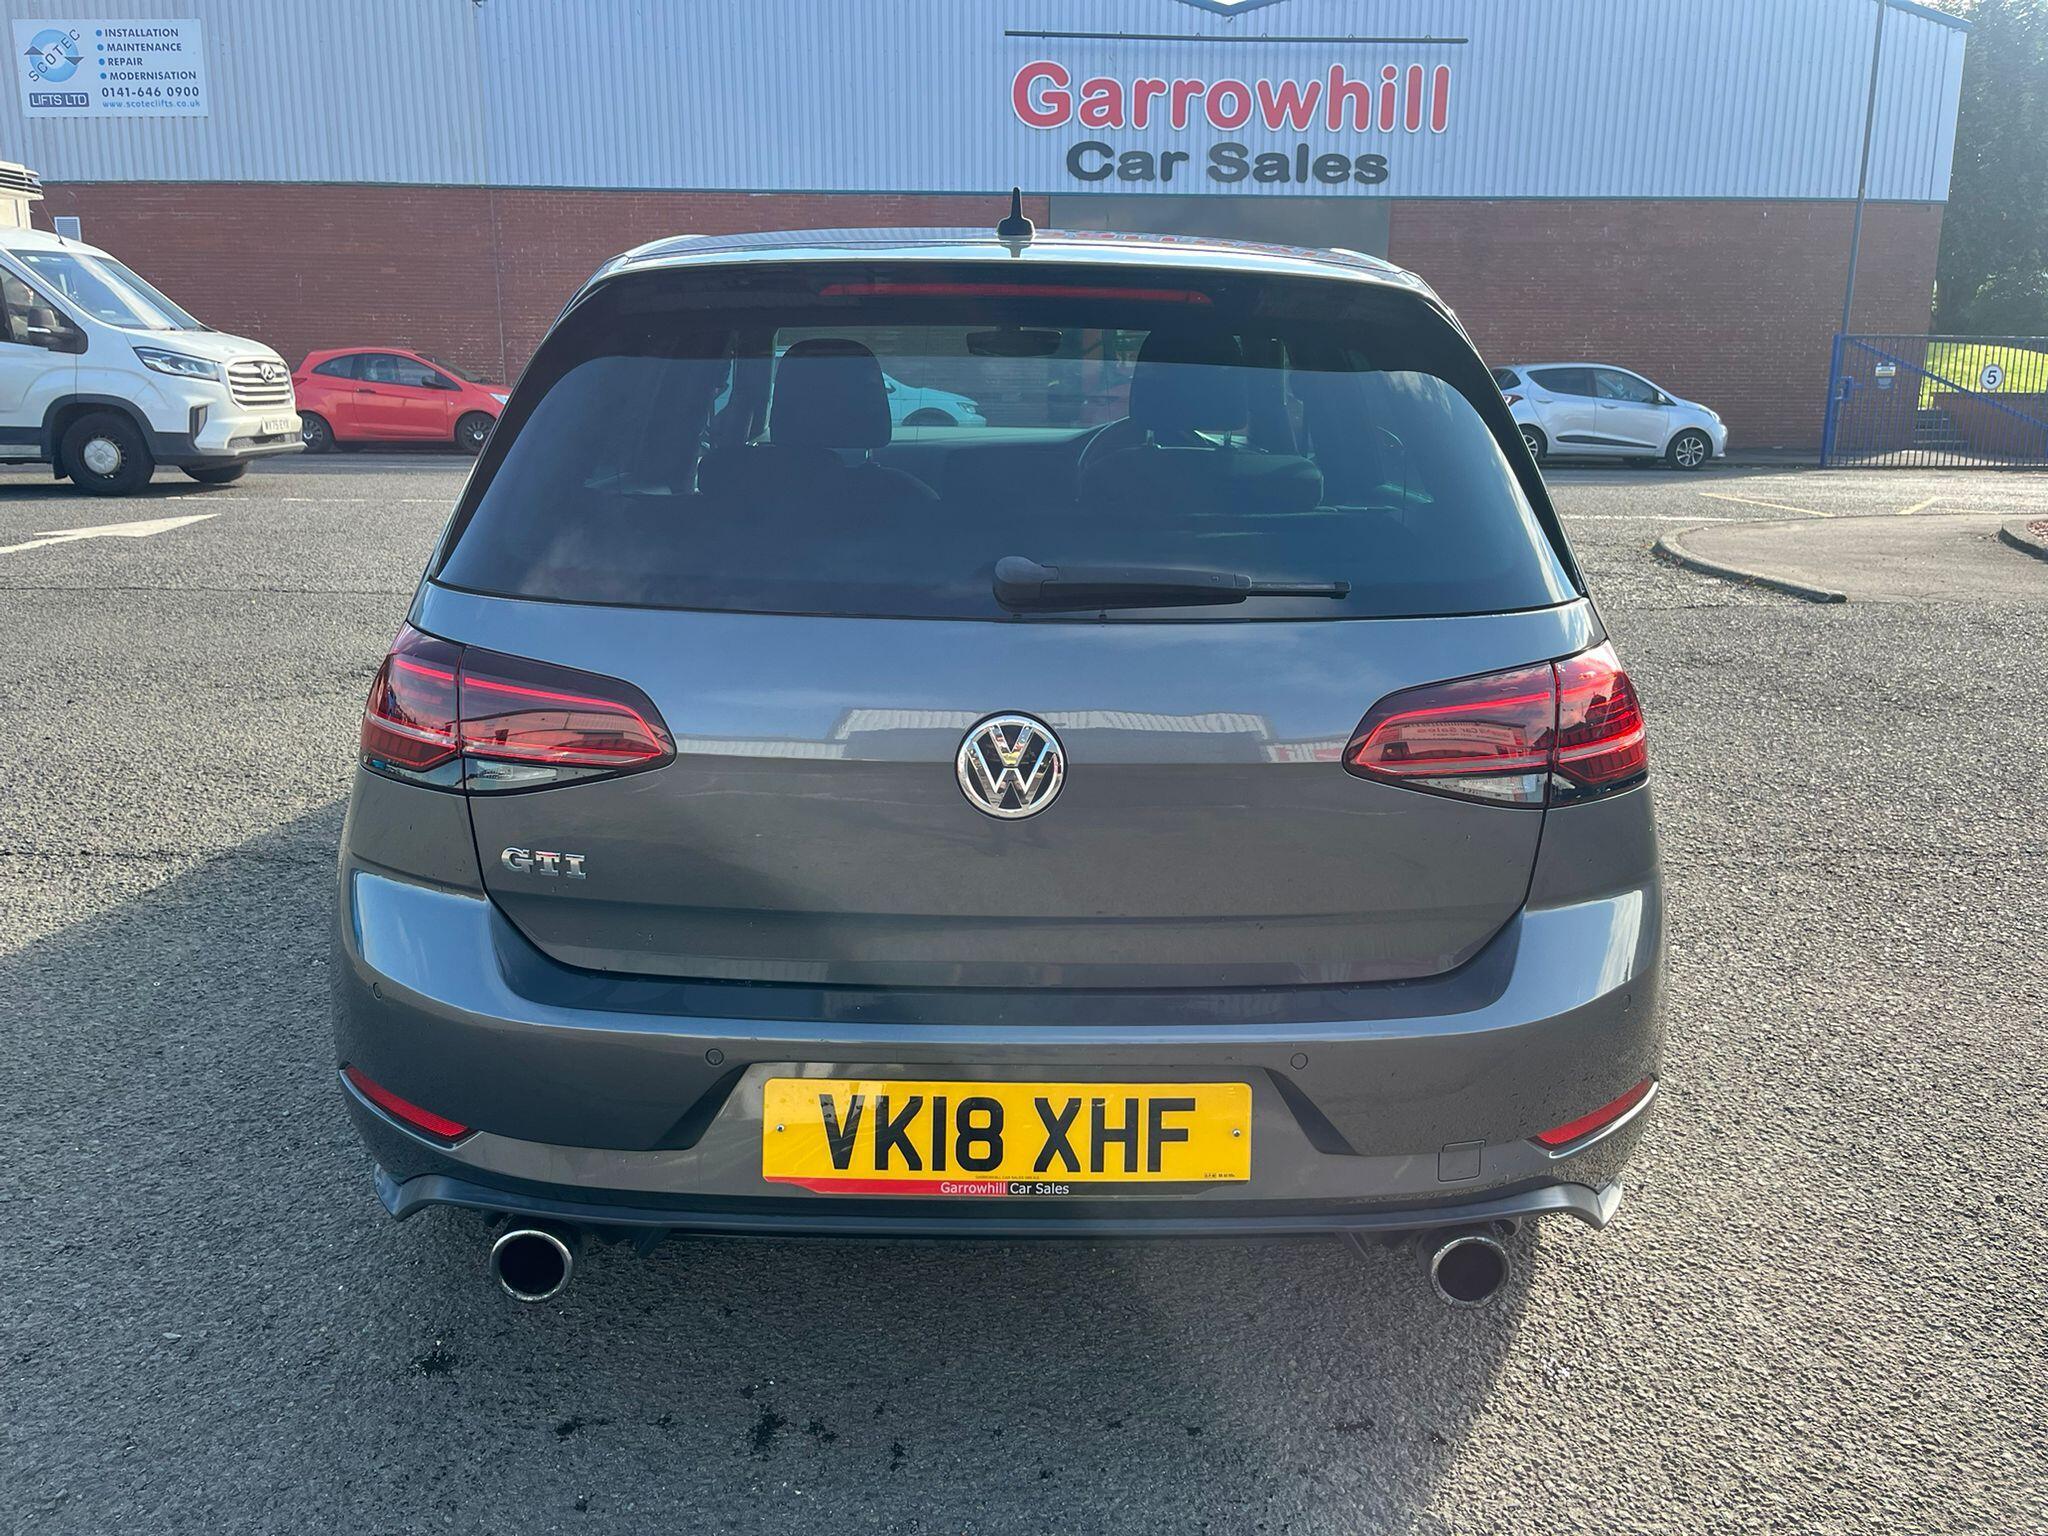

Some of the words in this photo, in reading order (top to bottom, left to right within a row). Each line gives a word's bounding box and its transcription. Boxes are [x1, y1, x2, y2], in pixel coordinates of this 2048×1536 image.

[104, 28, 179, 37] INSTALLATION
[106, 43, 182, 51] MAINTENANCE
[28, 28, 80, 82] SCOTEC
[107, 57, 143, 66] REPAIR
[109, 71, 196, 80] MODERNISATION
[101, 87, 161, 97] 0141-646
[167, 86, 199, 96] 0900
[1011, 60, 1452, 133] Garrowhill
[31, 94, 62, 106] LIFTS
[65, 94, 87, 105] LTD
[102, 100, 200, 108] www.scoteclifts.co.uk
[1066, 140, 1189, 182] Car
[1206, 142, 1389, 184] Sales
[1986, 370, 1997, 385] 5
[501, 847, 587, 880] GTI
[818, 1094, 1004, 1172] VK18
[1034, 1097, 1196, 1173] XHF
[940, 1181, 1006, 1194] Garrowhill
[1010, 1182, 1032, 1194] Car
[1035, 1182, 1070, 1195] Sales
